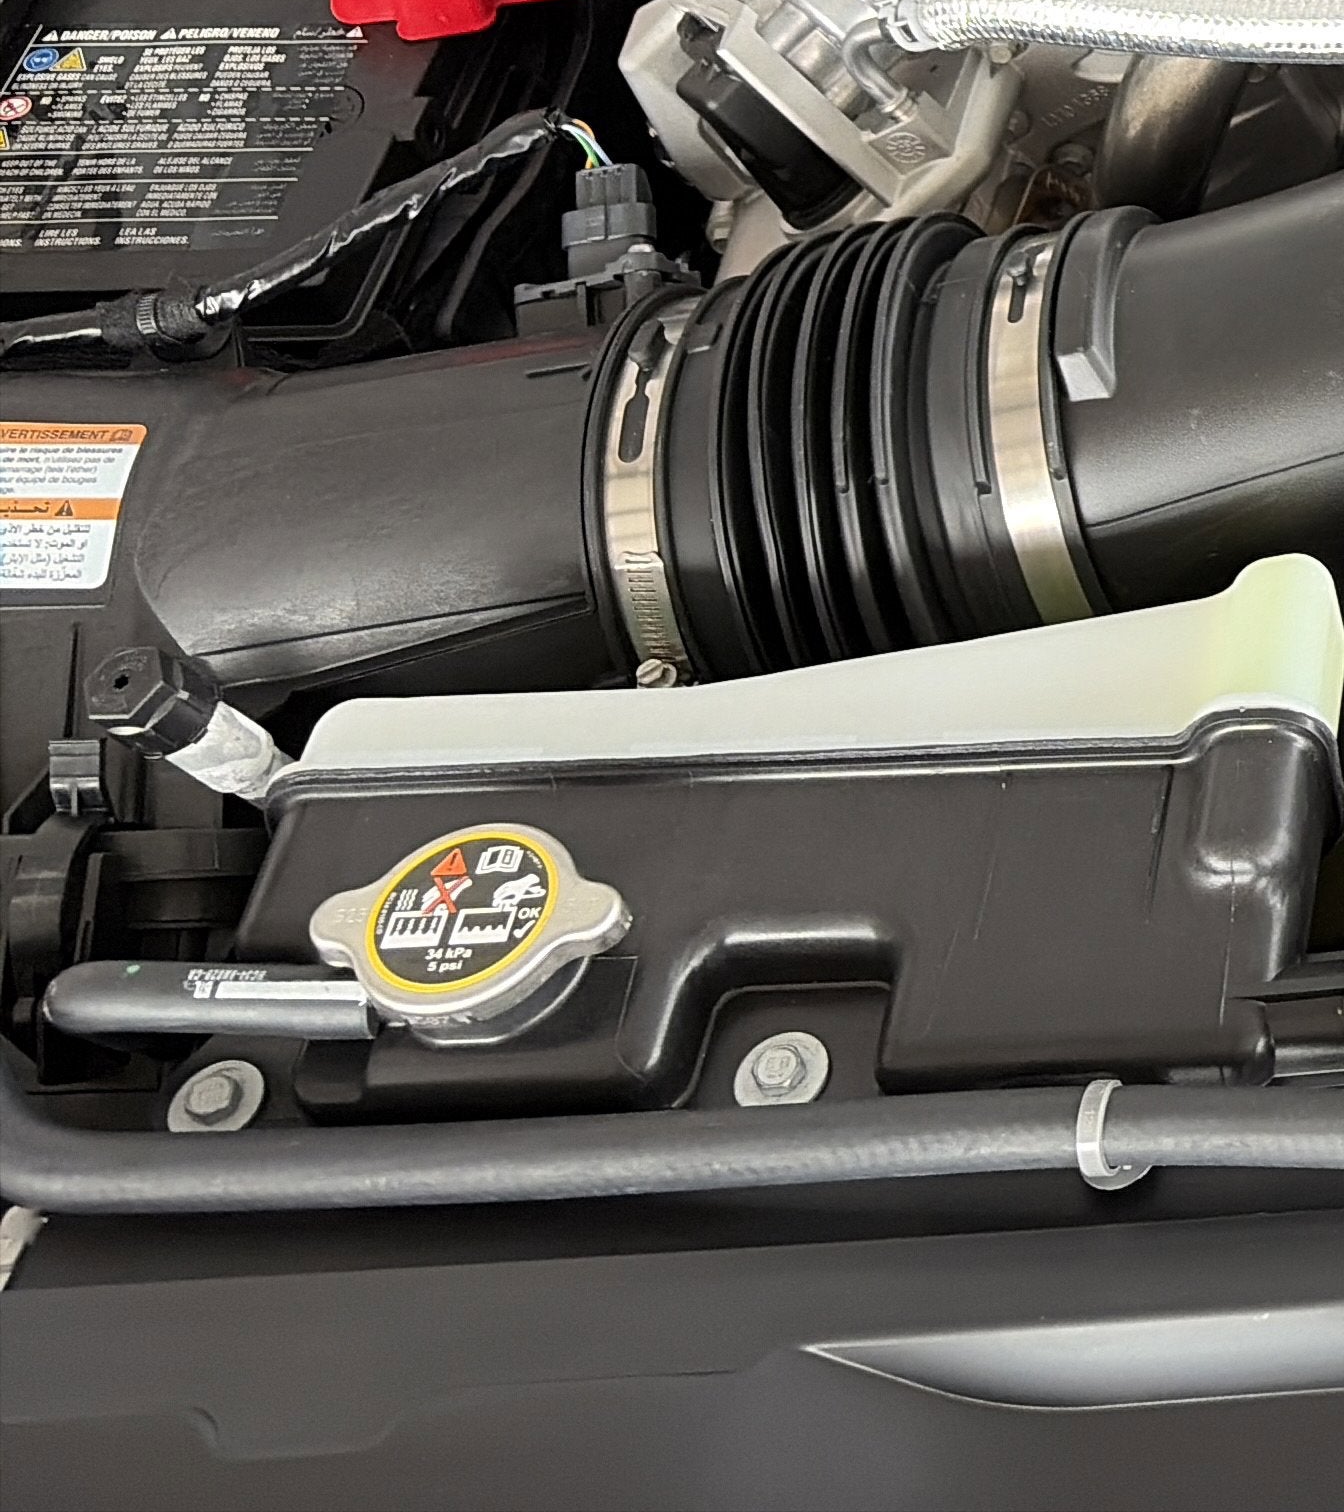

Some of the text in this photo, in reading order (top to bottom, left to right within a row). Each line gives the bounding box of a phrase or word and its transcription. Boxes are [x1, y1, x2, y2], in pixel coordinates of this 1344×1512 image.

[60, 29, 157, 41] DANGER/POISON
[178, 28, 280, 39] PELIGRO/VENENO
[0, 428, 110, 440] VERTISSEMENT
[517, 906, 542, 920] OK
[424, 947, 472, 961] 34 kPa
[426, 960, 462, 973] 5 psi
